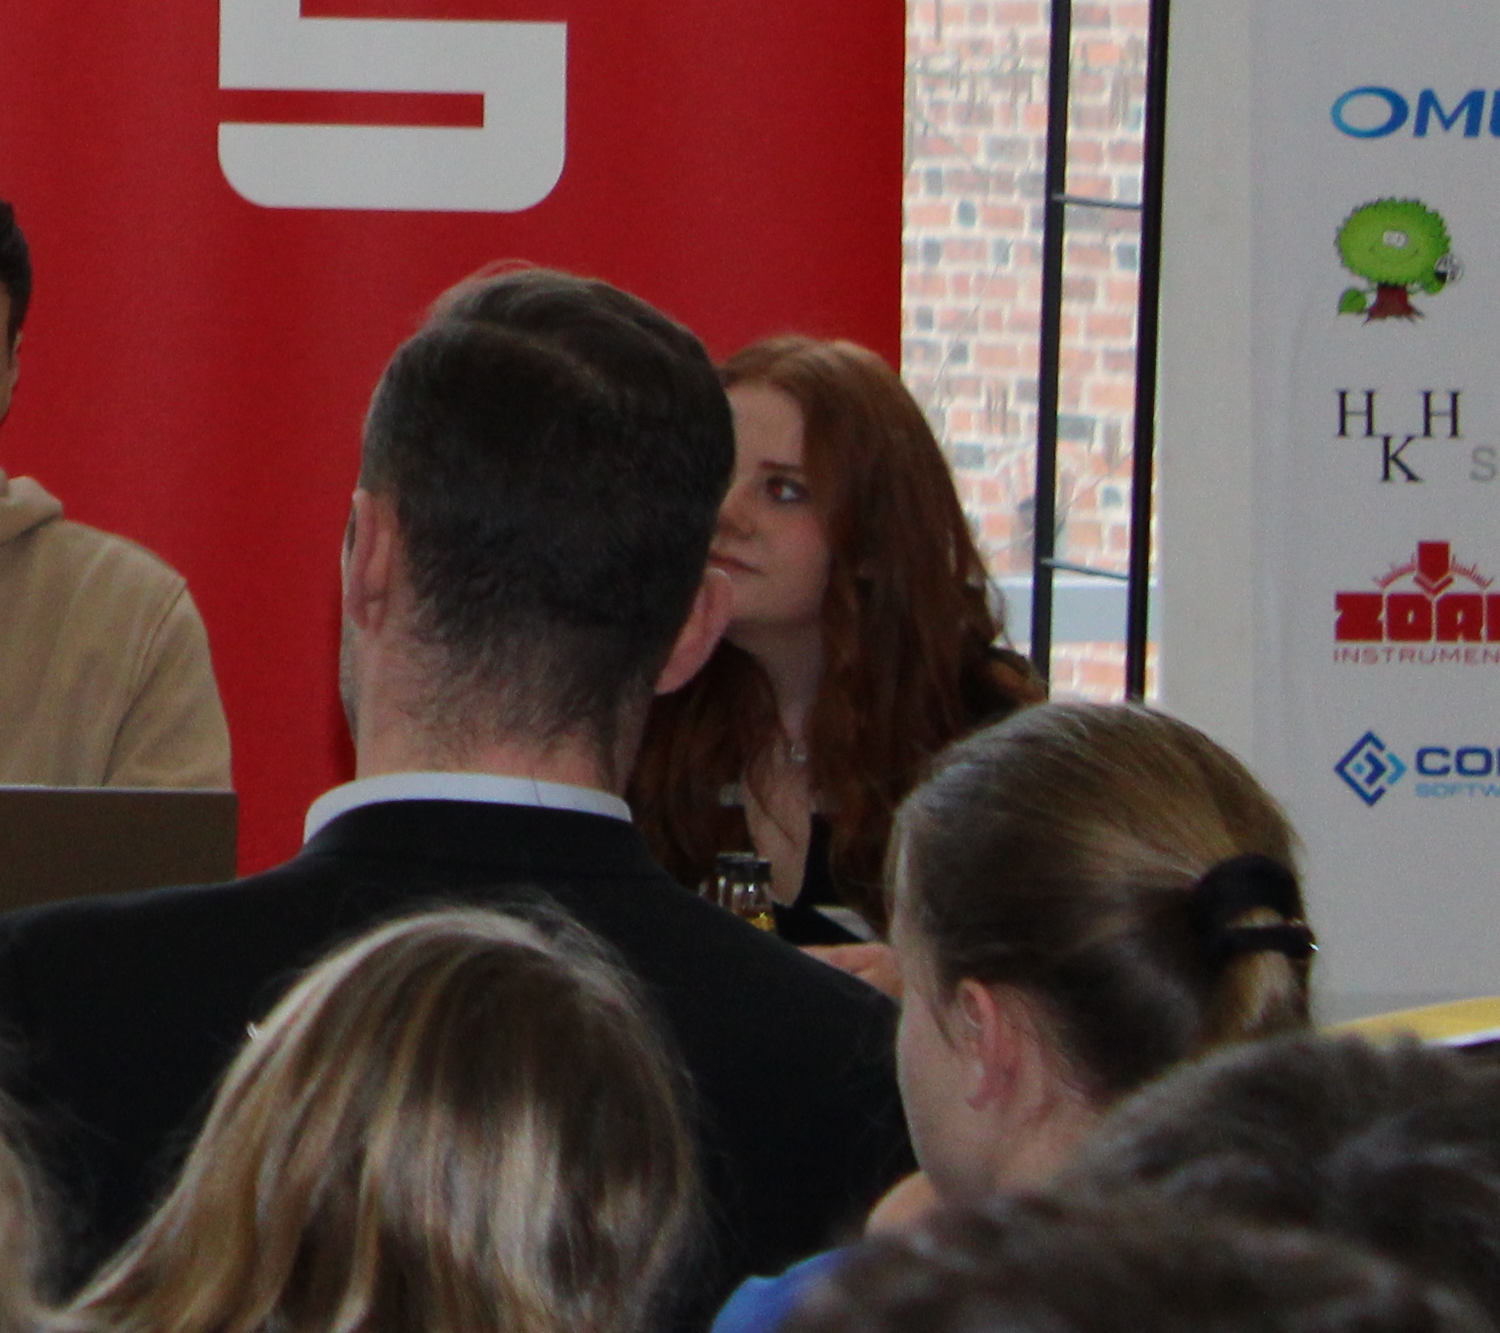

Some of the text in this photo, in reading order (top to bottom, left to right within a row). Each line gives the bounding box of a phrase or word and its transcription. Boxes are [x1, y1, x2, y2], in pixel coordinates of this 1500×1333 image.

[1333, 647, 1500, 665] INSTRUMEN
[1416, 746, 1500, 777] CO
[1416, 783, 1500, 798] SOFTW
